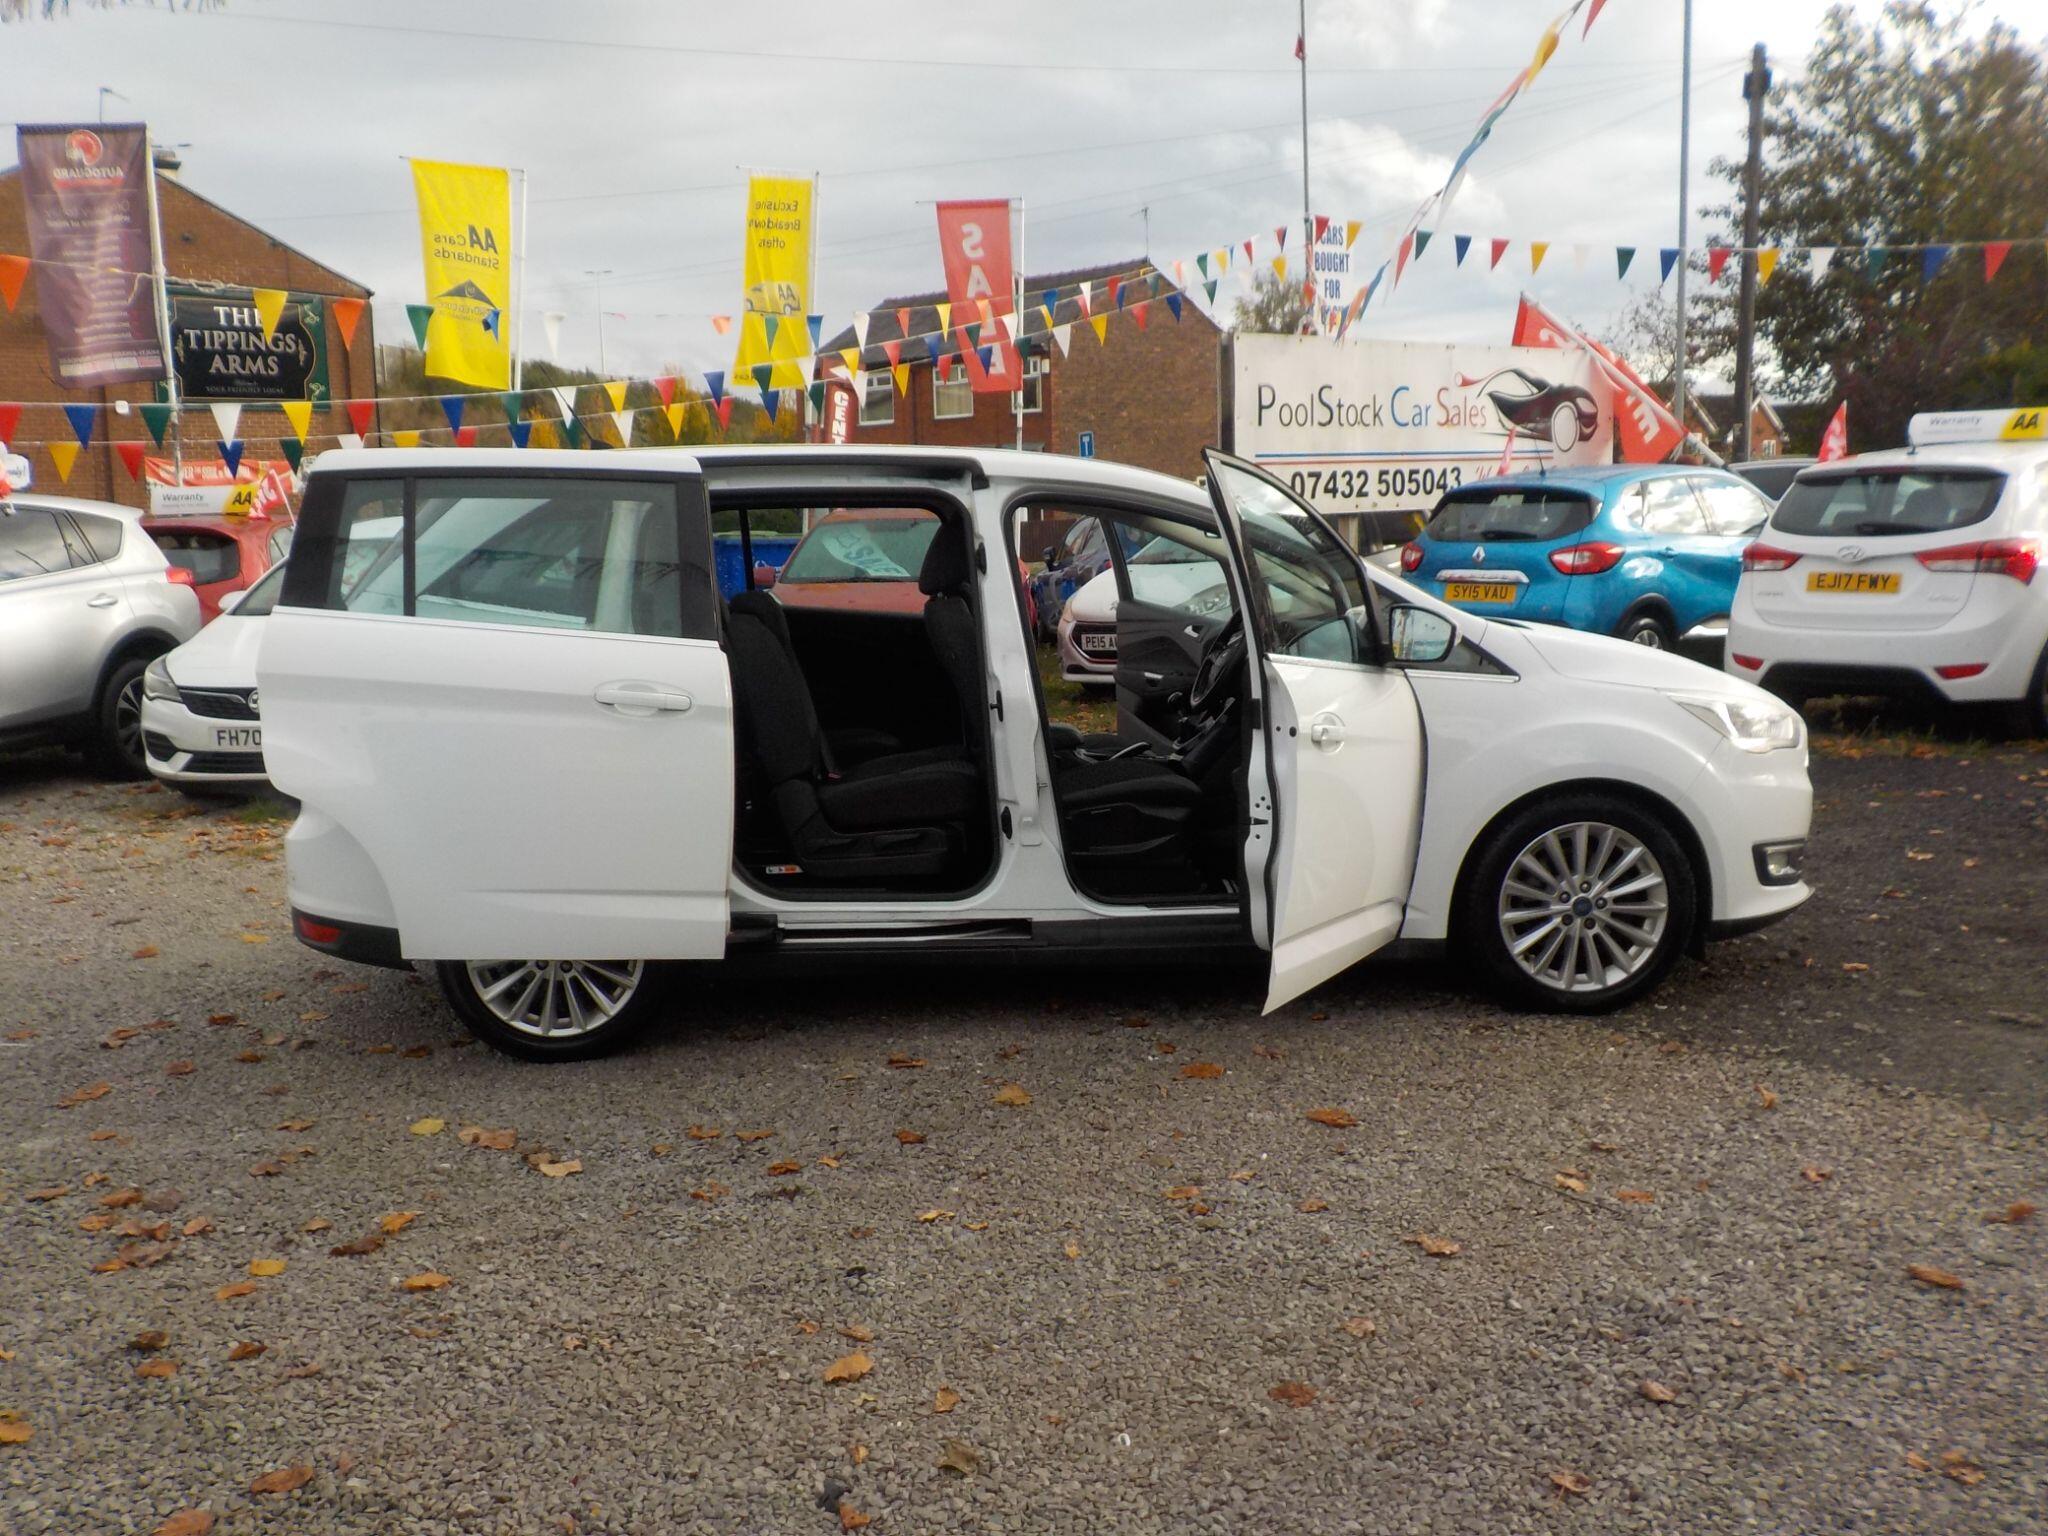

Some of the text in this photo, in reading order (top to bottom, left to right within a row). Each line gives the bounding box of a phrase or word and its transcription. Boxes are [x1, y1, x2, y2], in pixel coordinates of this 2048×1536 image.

[1314, 251, 1350, 273] BOUGHT
[1324, 278, 1341, 299] FOR
[183, 329, 297, 353] TIPPINGS
[209, 354, 280, 376] ARMS
[1257, 384, 1488, 428] PoolStock Car Sales
[1929, 412, 2041, 431] Warranty AA
[1290, 470, 1370, 500] 07432
[1376, 467, 1462, 498] 505043
[162, 490, 253, 507] Warranty AA
[1816, 573, 1892, 590] EJ17 FWY
[1453, 585, 1509, 600] SY15 VAU
[1085, 636, 1106, 649] PE15
[216, 729, 262, 747] FH70
